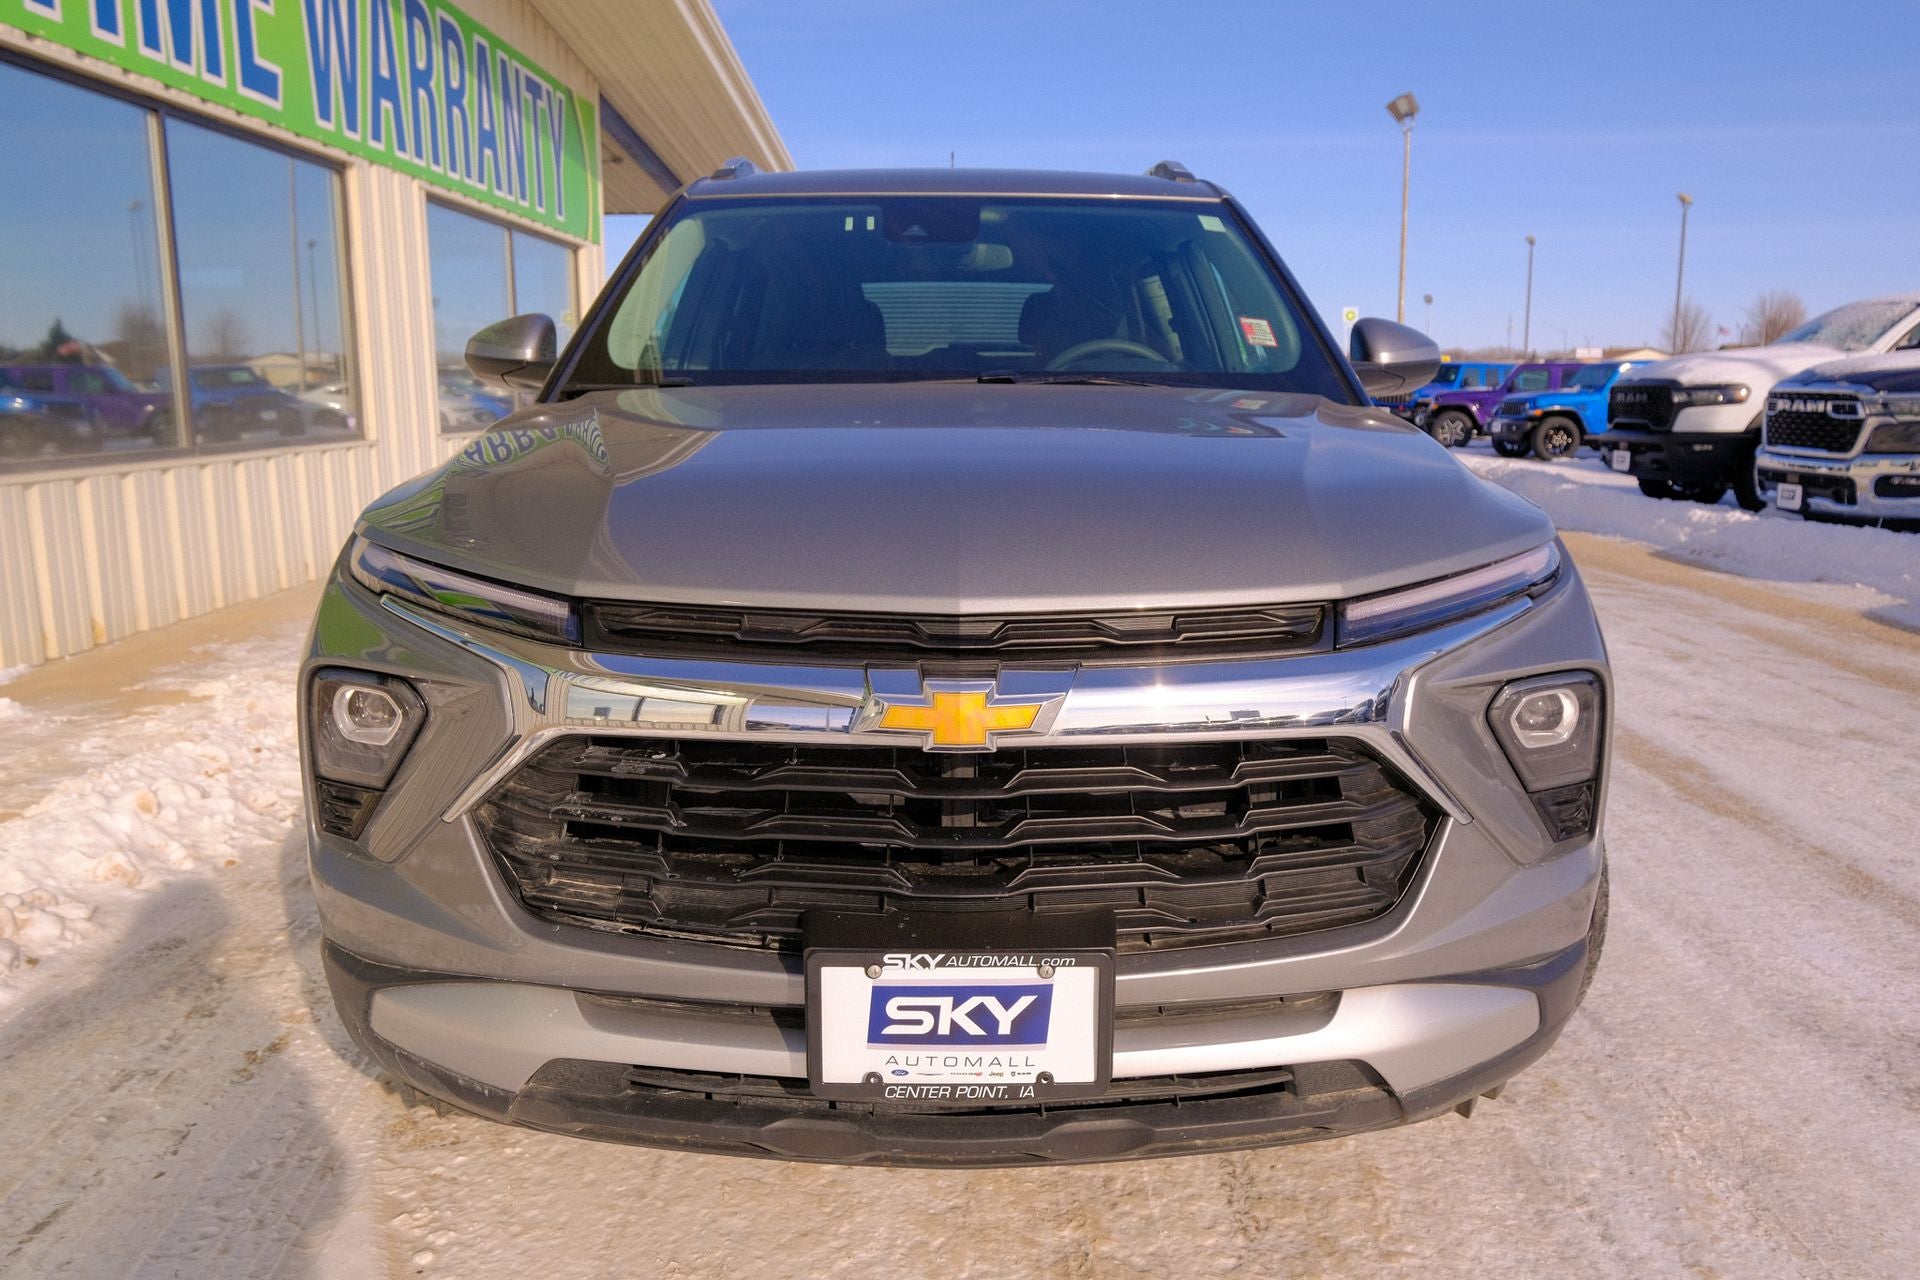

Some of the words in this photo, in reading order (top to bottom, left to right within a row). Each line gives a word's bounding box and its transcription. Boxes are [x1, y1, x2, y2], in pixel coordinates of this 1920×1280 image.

[302, 0, 567, 222] WARRANTY
[1615, 392, 1648, 403] RAM
[1777, 399, 1826, 413] RAM
[883, 953, 946, 970] SKY
[945, 955, 1076, 967] AUTOMALL.com
[881, 995, 1038, 1036] SKY
[885, 1055, 1036, 1068] AUTOMALL
[885, 1085, 951, 1099] CENTER
[955, 1085, 1009, 1100] POINT,
[1019, 1085, 1035, 1098] IA
